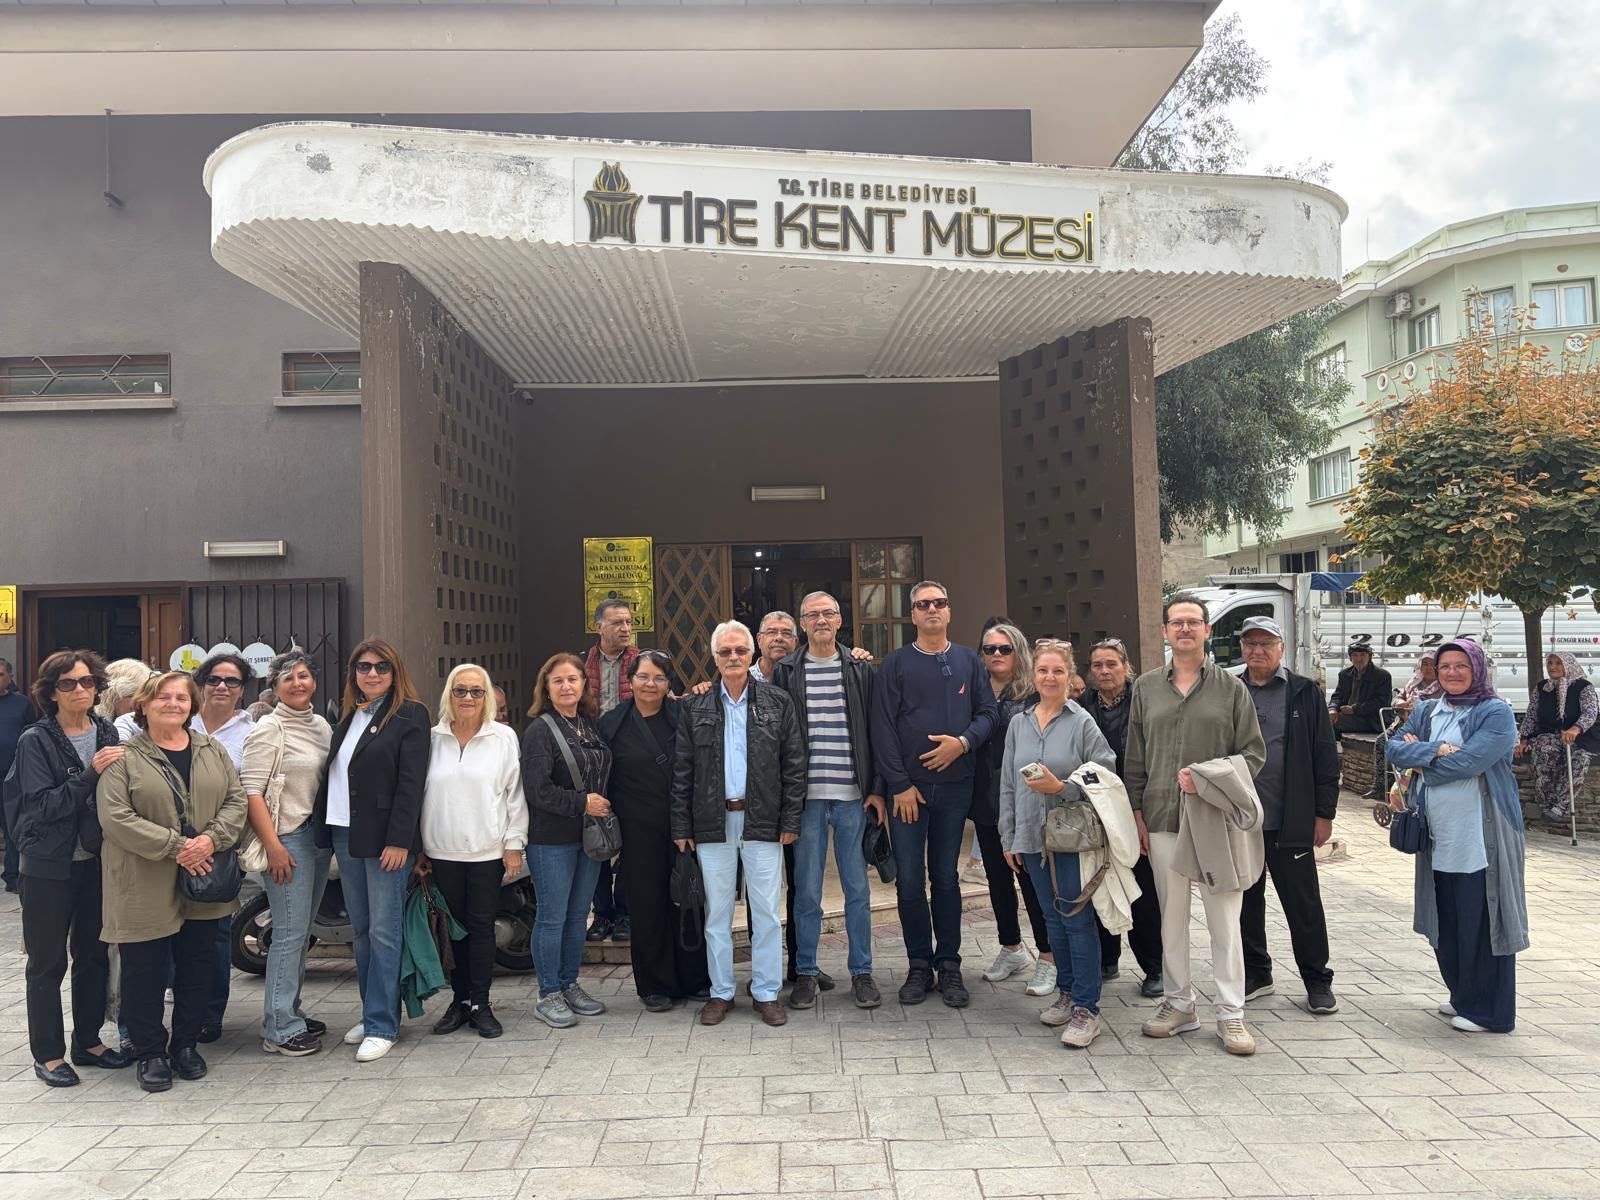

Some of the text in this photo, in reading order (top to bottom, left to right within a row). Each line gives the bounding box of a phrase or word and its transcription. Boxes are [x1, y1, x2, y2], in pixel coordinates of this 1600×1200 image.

[808, 178, 854, 199] TİRE
[860, 183, 977, 205] BELEDİYESİ
[647, 190, 1094, 263] TİRE KENT MÜZESİ
